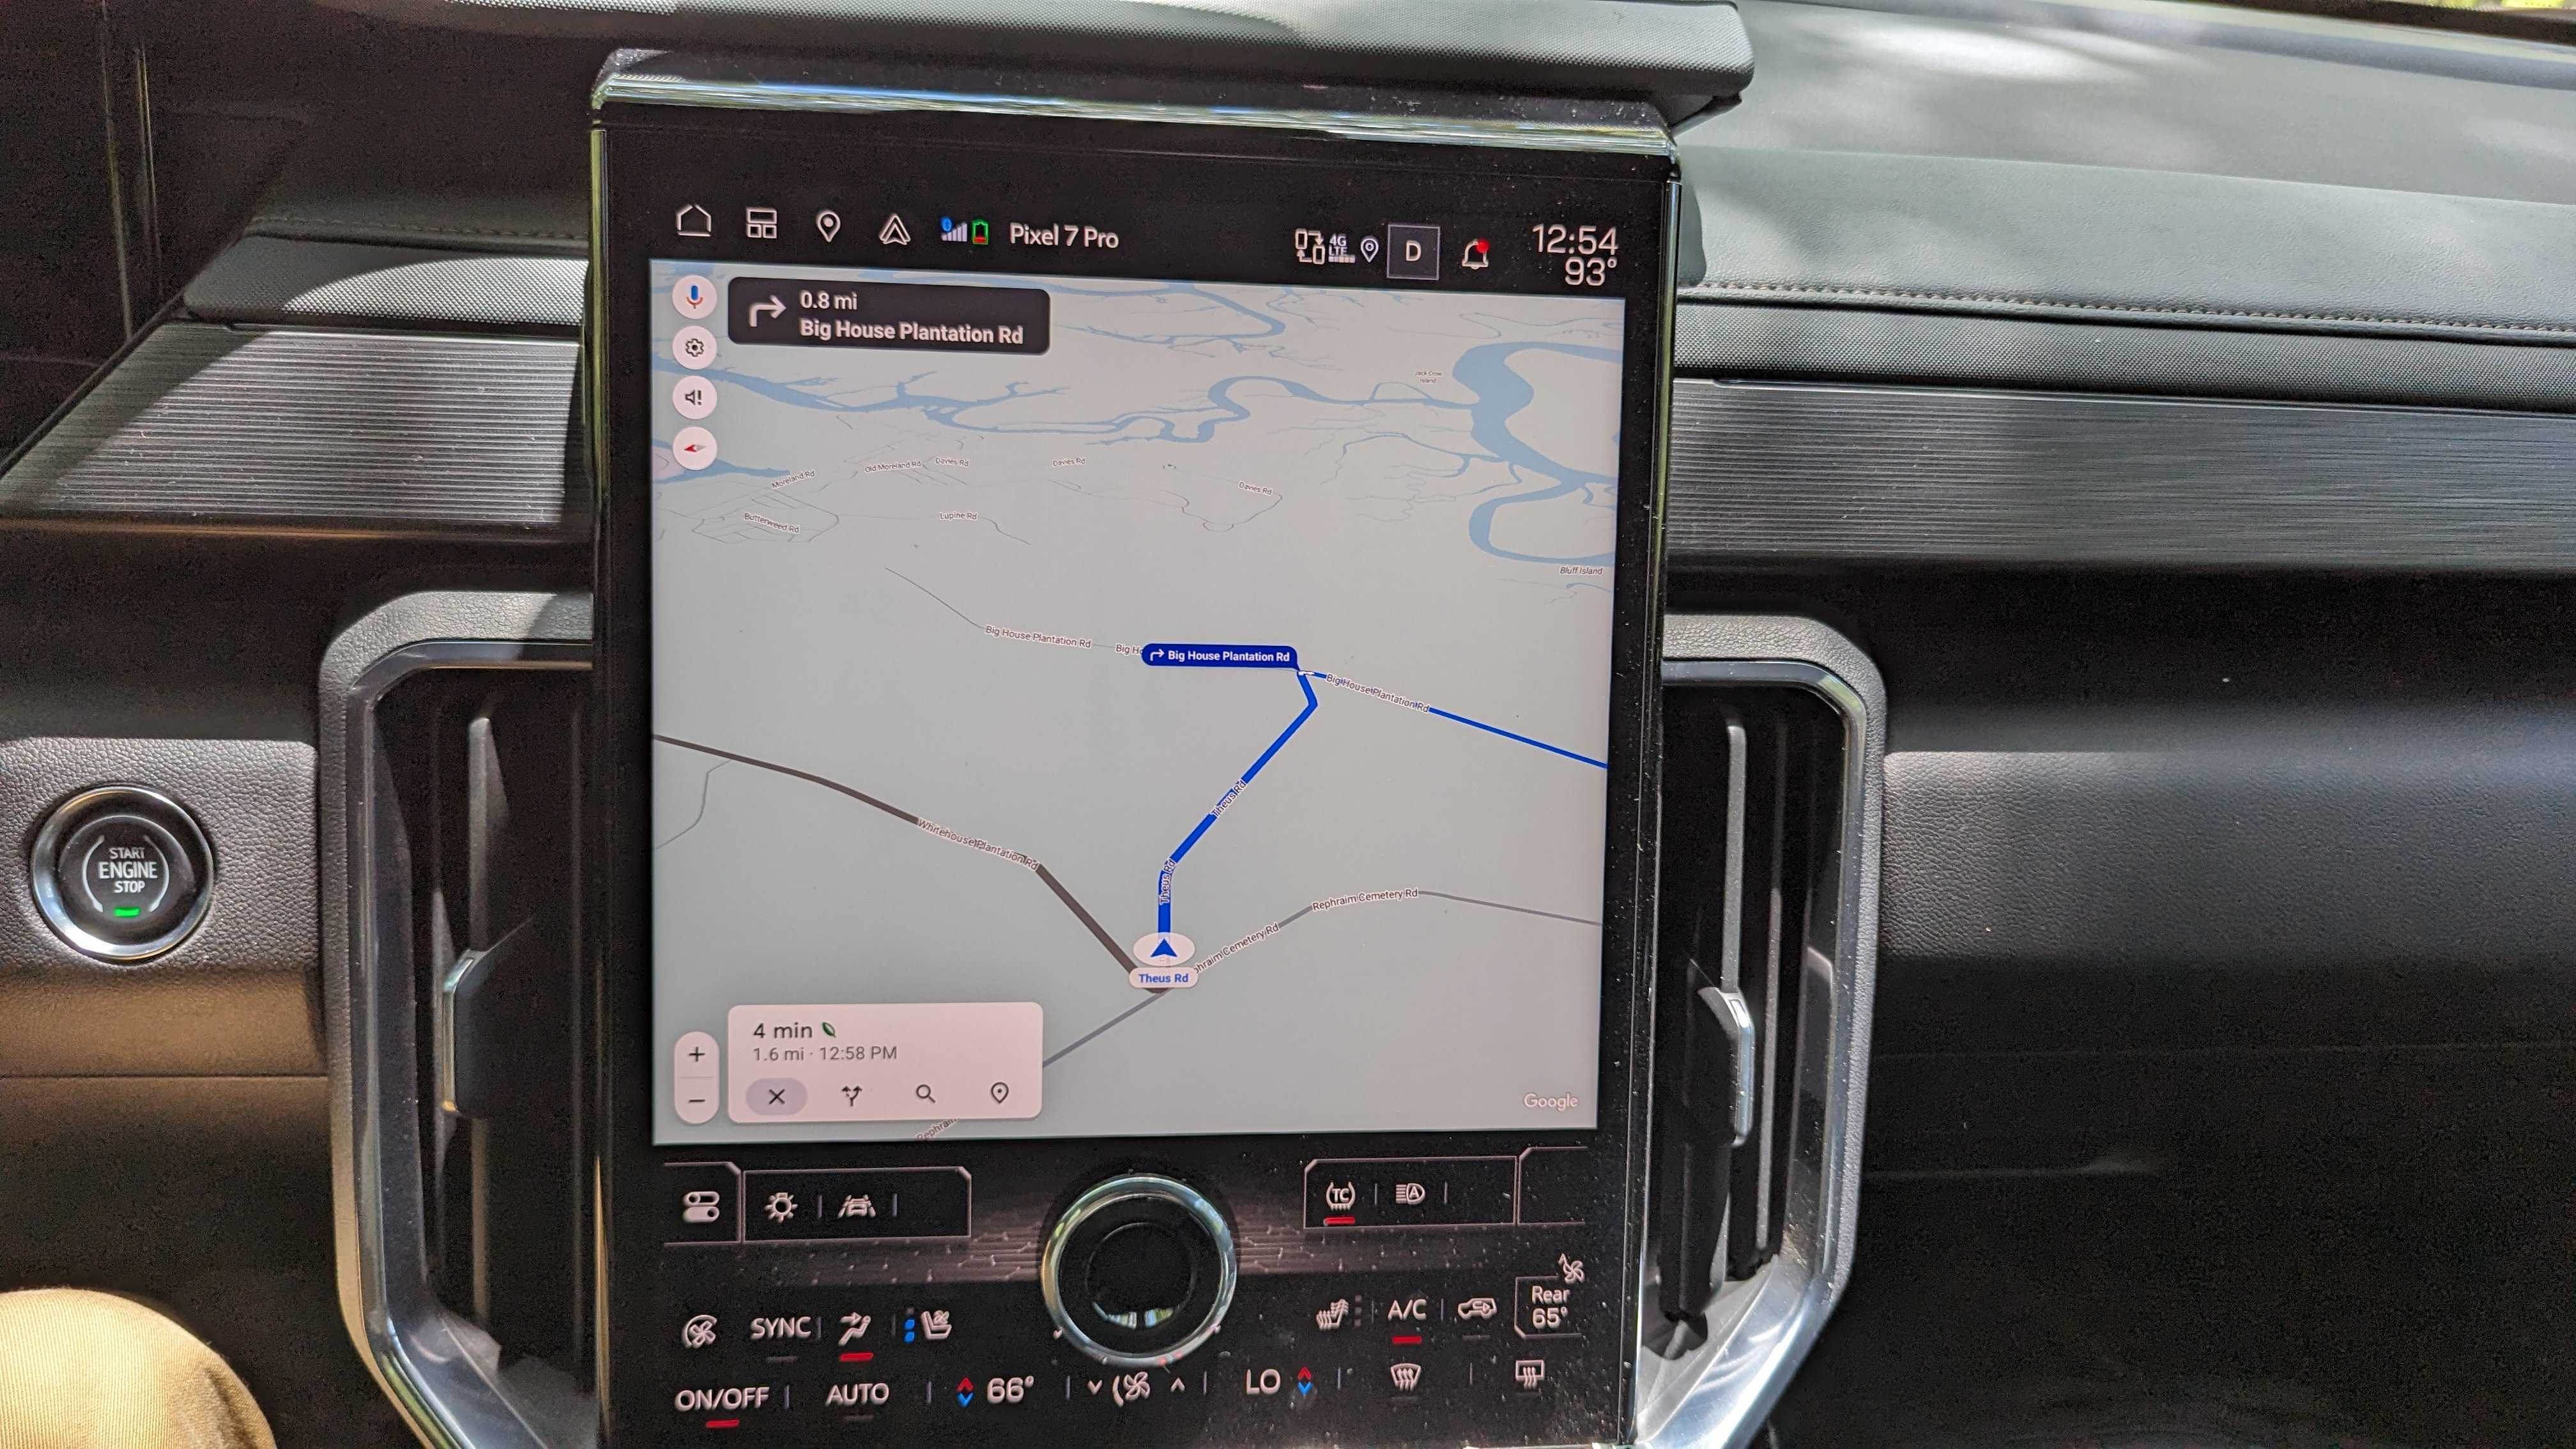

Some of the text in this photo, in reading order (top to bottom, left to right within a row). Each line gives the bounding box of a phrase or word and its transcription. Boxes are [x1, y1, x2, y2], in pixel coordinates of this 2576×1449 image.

[1009, 222, 1119, 249] Pixel 7 Pro
[1329, 233, 1347, 246] 4G
[1532, 223, 1619, 255] 12:54
[1328, 247, 1347, 256] LTE
[1406, 240, 1422, 261] D
[1565, 256, 1618, 286] 93°
[800, 290, 858, 310] 0.8 mi
[800, 318, 1023, 344] Big House Plantation Rd
[864, 459, 922, 473] Old Moreland Rd
[935, 456, 970, 468] Davies Rd
[1052, 459, 1075, 467] Davies
[771, 470, 815, 489] Moreland Rd
[1238, 480, 1273, 496] Davies Rd
[744, 512, 799, 533] Butterweed Rd
[940, 512, 965, 521] Lupine
[1560, 566, 1603, 575] Bluff Island
[985, 625, 1091, 648] Big House Plantation Rd
[1115, 643, 1131, 656] Big
[1168, 650, 1290, 662] Big House Plantation Rd
[1326, 673, 1430, 714] Big House Plantation Rd
[1212, 779, 1247, 818] Theus Rd
[109, 847, 145, 859] START
[918, 818, 1039, 871] Whitehouse Plantation Rd
[98, 861, 158, 879] ENGINE
[112, 880, 146, 893] STOP
[1160, 859, 1176, 905] Theus Rd
[1312, 888, 1418, 911] Rephraim Cemetery Rd
[1222, 929, 1265, 956] Cemetery
[1265, 923, 1280, 935] Rd
[1138, 973, 1189, 983] Theus Rd
[753, 1022, 813, 1039] 4 min
[753, 1045, 898, 1061] 1.6 mi 12:58 PM
[1523, 1092, 1579, 1111] Google
[916, 1118, 959, 1140] Rephrai
[1332, 1187, 1350, 1203] TC
[1531, 1285, 1571, 1305] Rear
[1387, 1298, 1428, 1321] A/C
[1532, 1306, 1569, 1330] 65°
[749, 1315, 813, 1340] SYNC
[986, 1375, 1035, 1404] 66°
[1246, 1368, 1281, 1395] LO
[674, 1386, 770, 1412] ON/OFF
[825, 1382, 890, 1406] AUTO
